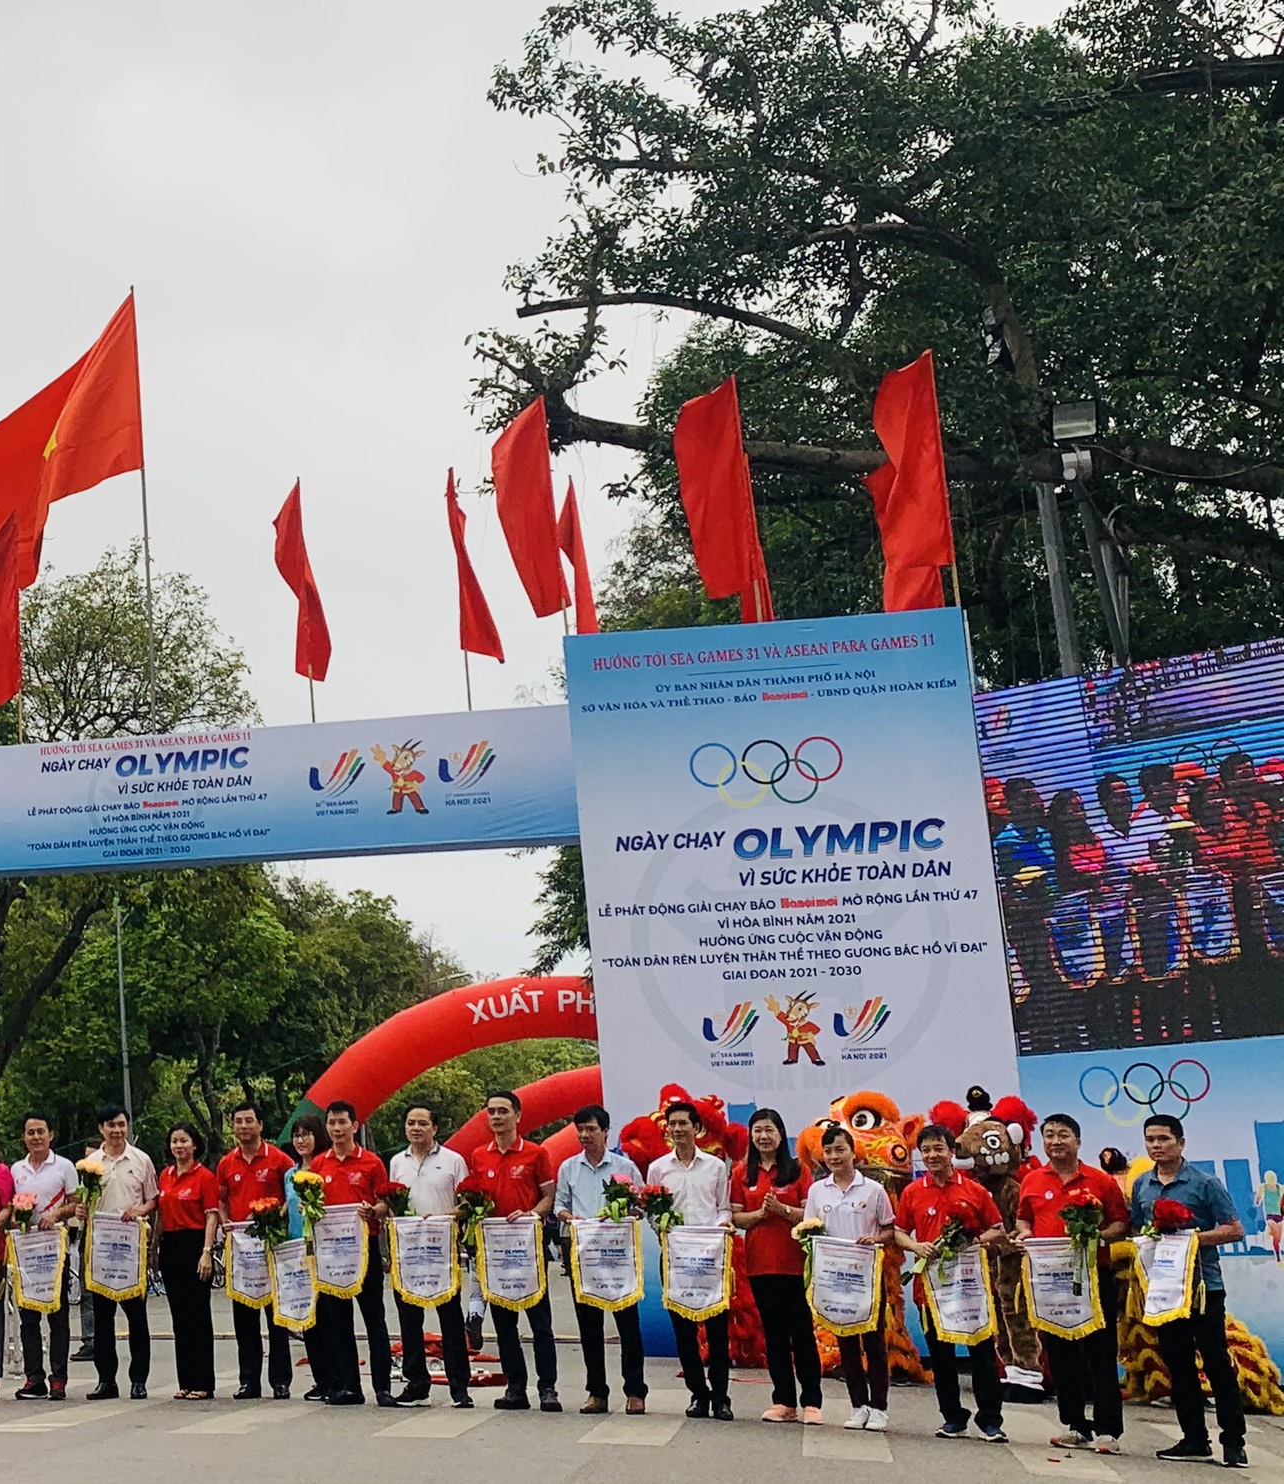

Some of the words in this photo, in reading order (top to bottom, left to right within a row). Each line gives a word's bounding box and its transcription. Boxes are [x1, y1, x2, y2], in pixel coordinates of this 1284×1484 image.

[41, 758, 76, 773] NGÀY
[78, 757, 111, 771] CHẠY
[115, 746, 250, 777] OLYMPIC
[118, 782, 128, 795] VÌ
[131, 781, 155, 794] SỨC
[157, 777, 189, 792] KHỎE
[192, 776, 224, 789] TOÀN
[226, 775, 252, 787] DÂN
[616, 830, 669, 852] NGÀY
[673, 831, 726, 850] CHẠY
[733, 818, 946, 860] OLYMPIC
[740, 868, 755, 886] VÌ
[761, 867, 796, 885] SỨC
[802, 862, 851, 883] KHỎE
[857, 861, 905, 880] TOÀN
[912, 860, 951, 878] DÂN
[598, 904, 612, 917] LỄ
[615, 904, 645, 916] PHÁT
[648, 903, 685, 916] ĐỘNG
[688, 901, 711, 913] GIẢI
[714, 901, 746, 913] CHẠY
[750, 898, 776, 910] BÁO
[842, 893, 863, 906] MỞ
[866, 892, 902, 906] RỘNG
[906, 889, 930, 903] LẦN
[933, 889, 959, 901] THỨ
[963, 890, 977, 899] 47
[717, 917, 729, 929] VÌ
[733, 916, 760, 928] HÒA
[763, 915, 793, 927] BÌNH
[796, 913, 825, 925] NĂM
[828, 914, 855, 924] 2021
[699, 934, 745, 946] HƯỞNG
[748, 933, 775, 945] ỨNG
[778, 931, 814, 945] CUỘC
[816, 930, 841, 943] VẬN
[844, 928, 883, 942] ĐỘNG
[723, 971, 746, 980] GIAI
[749, 969, 786, 980] ĐOẠN
[789, 968, 817, 978] 2021
[829, 966, 861, 976] 2030
[466, 984, 544, 1025] XUẤT
